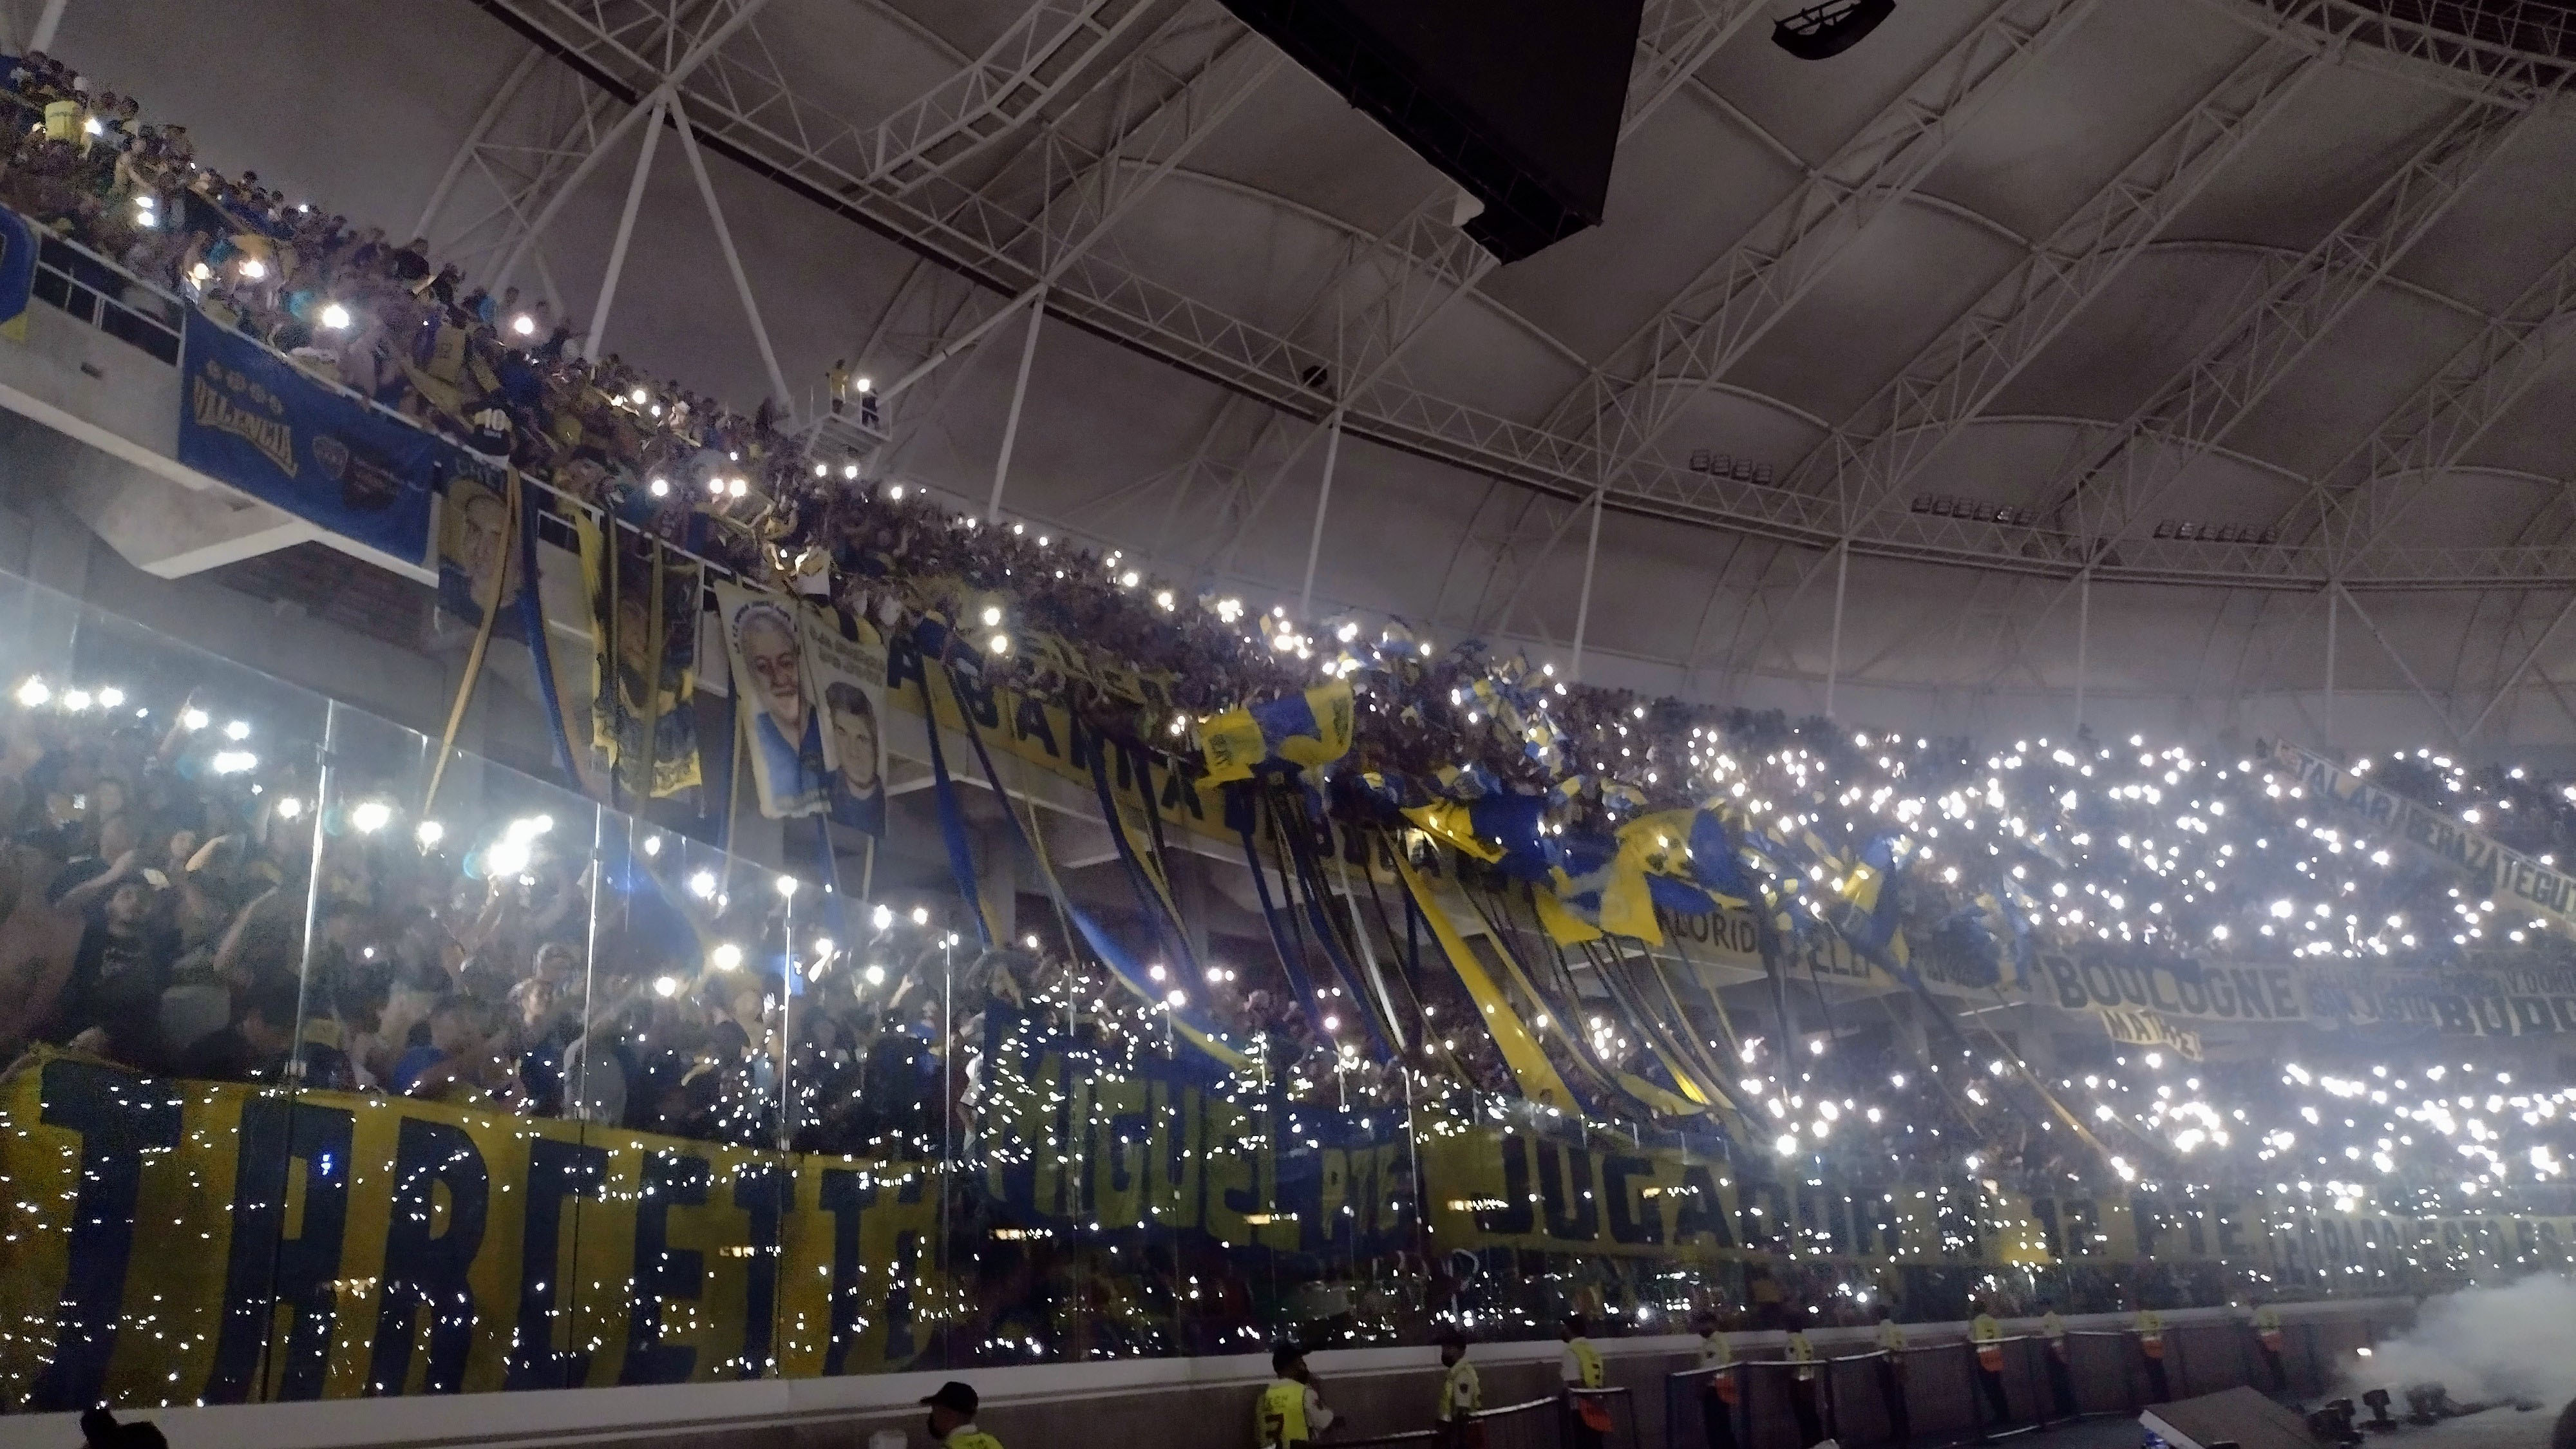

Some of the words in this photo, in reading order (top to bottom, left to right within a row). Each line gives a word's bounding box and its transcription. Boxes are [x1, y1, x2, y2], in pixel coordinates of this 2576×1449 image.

[194, 375, 295, 475] VALENCIA
[484, 408, 507, 431] 10
[2044, 956, 2301, 1019] BOULOGNE
[987, 1025, 1300, 1252] MIGUEL
[1470, 1133, 1900, 1256] JUGADOR
